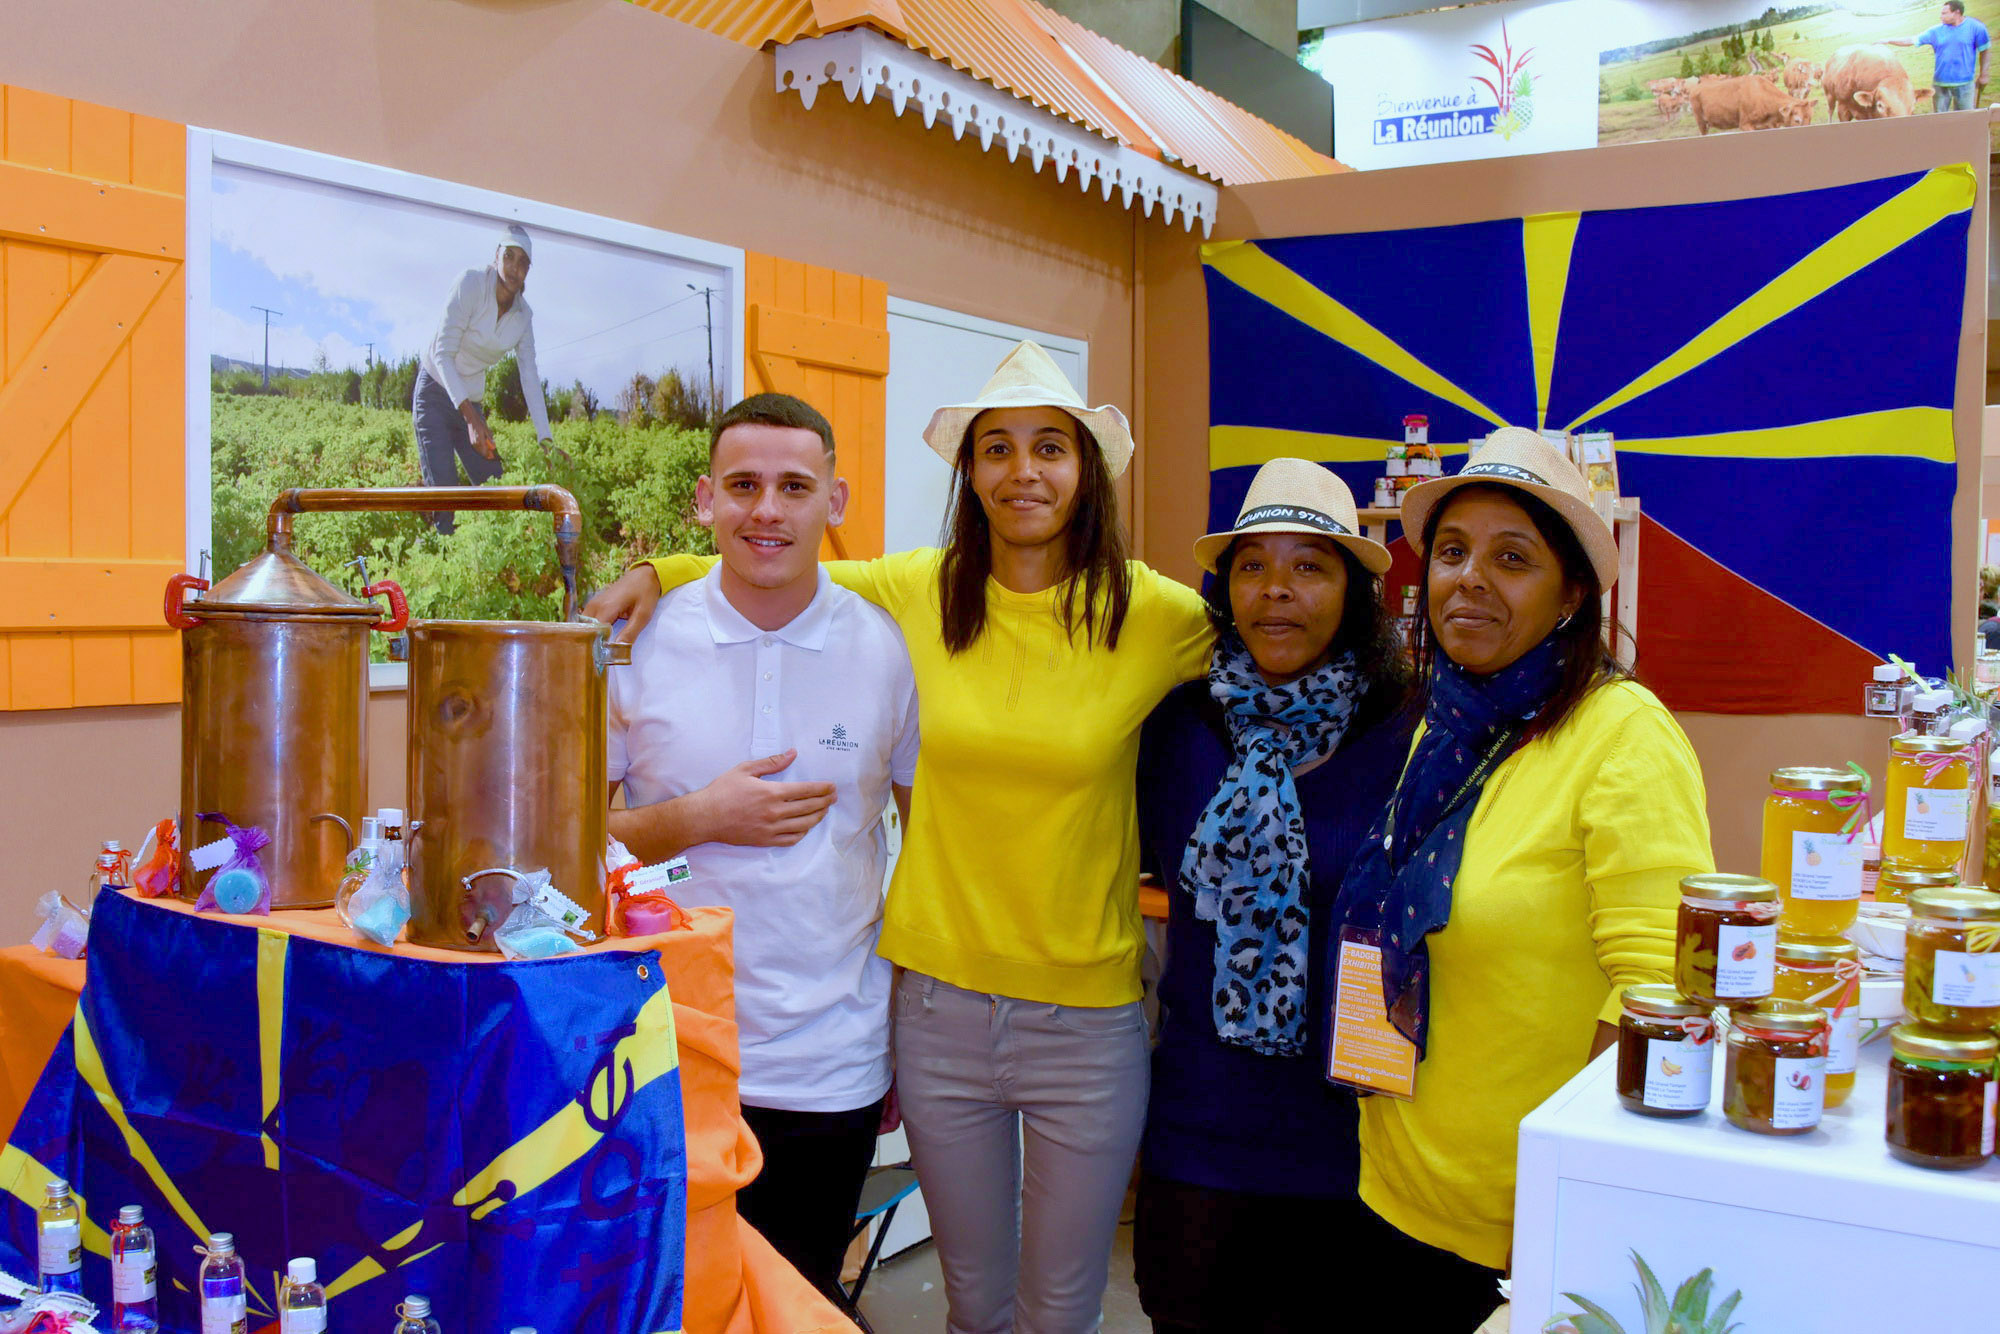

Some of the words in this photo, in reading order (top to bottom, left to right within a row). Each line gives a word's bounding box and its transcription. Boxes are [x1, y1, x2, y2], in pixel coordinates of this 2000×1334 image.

[1377, 91, 1462, 117] Bienvenue
[1466, 86, 1479, 105] à
[1375, 121, 1398, 144] La
[1402, 111, 1485, 141] Réunion
[1298, 511, 1325, 525] 974
